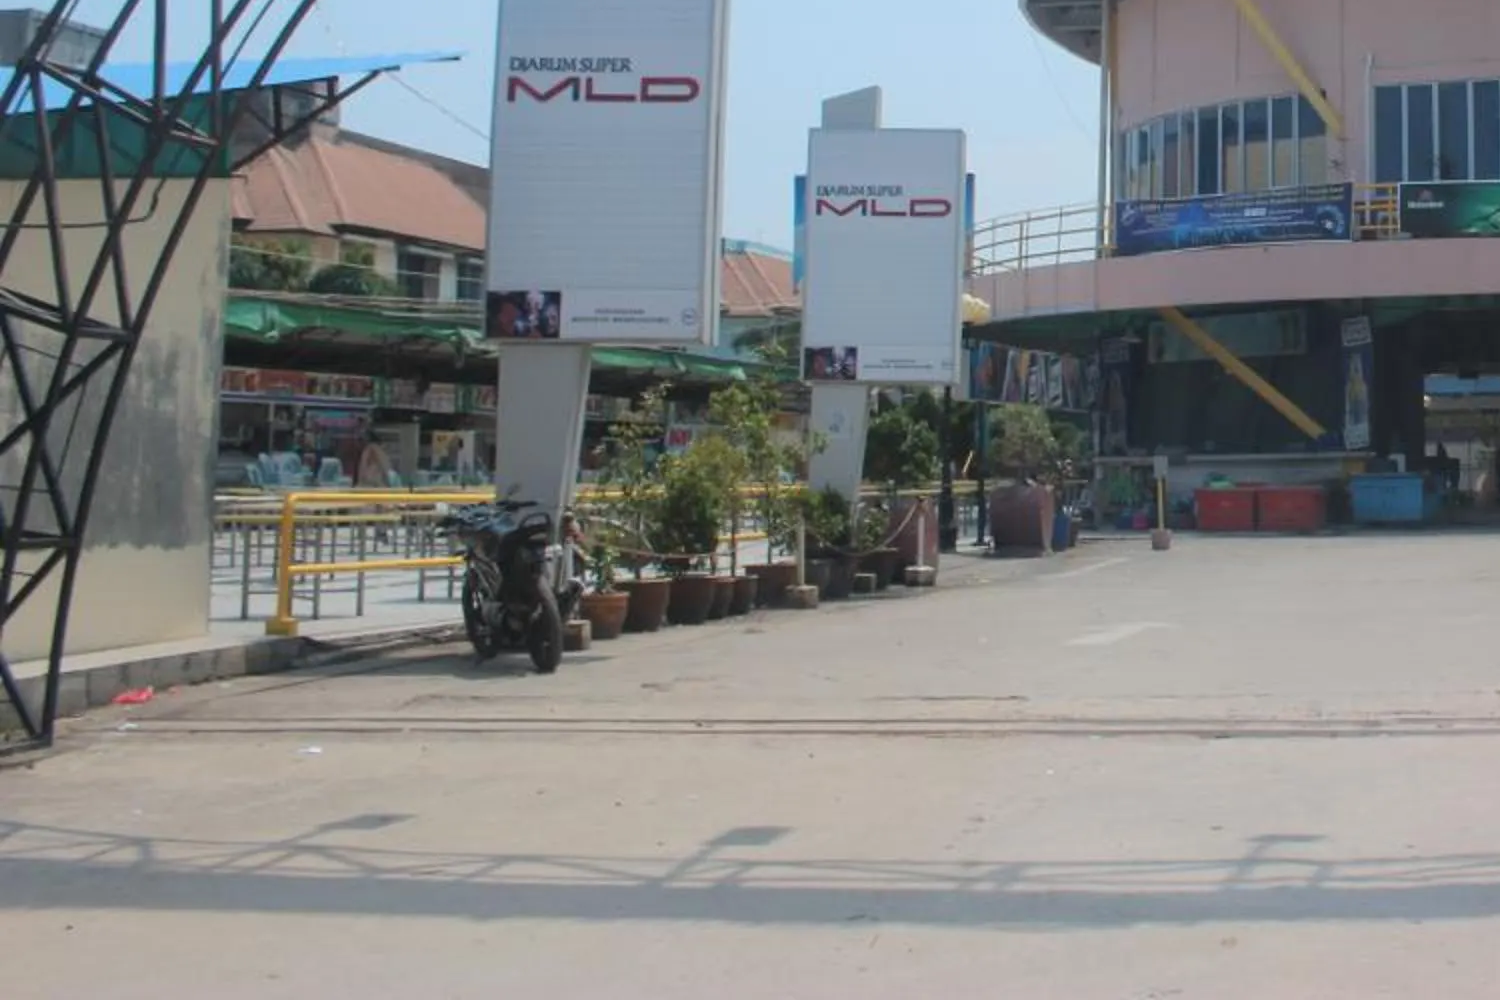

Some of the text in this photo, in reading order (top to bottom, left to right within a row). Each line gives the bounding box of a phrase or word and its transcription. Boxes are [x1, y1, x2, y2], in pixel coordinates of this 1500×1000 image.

[509, 56, 633, 73] DJARUM SUPER
[507, 75, 701, 103] MLD
[815, 198, 952, 217] MLD
